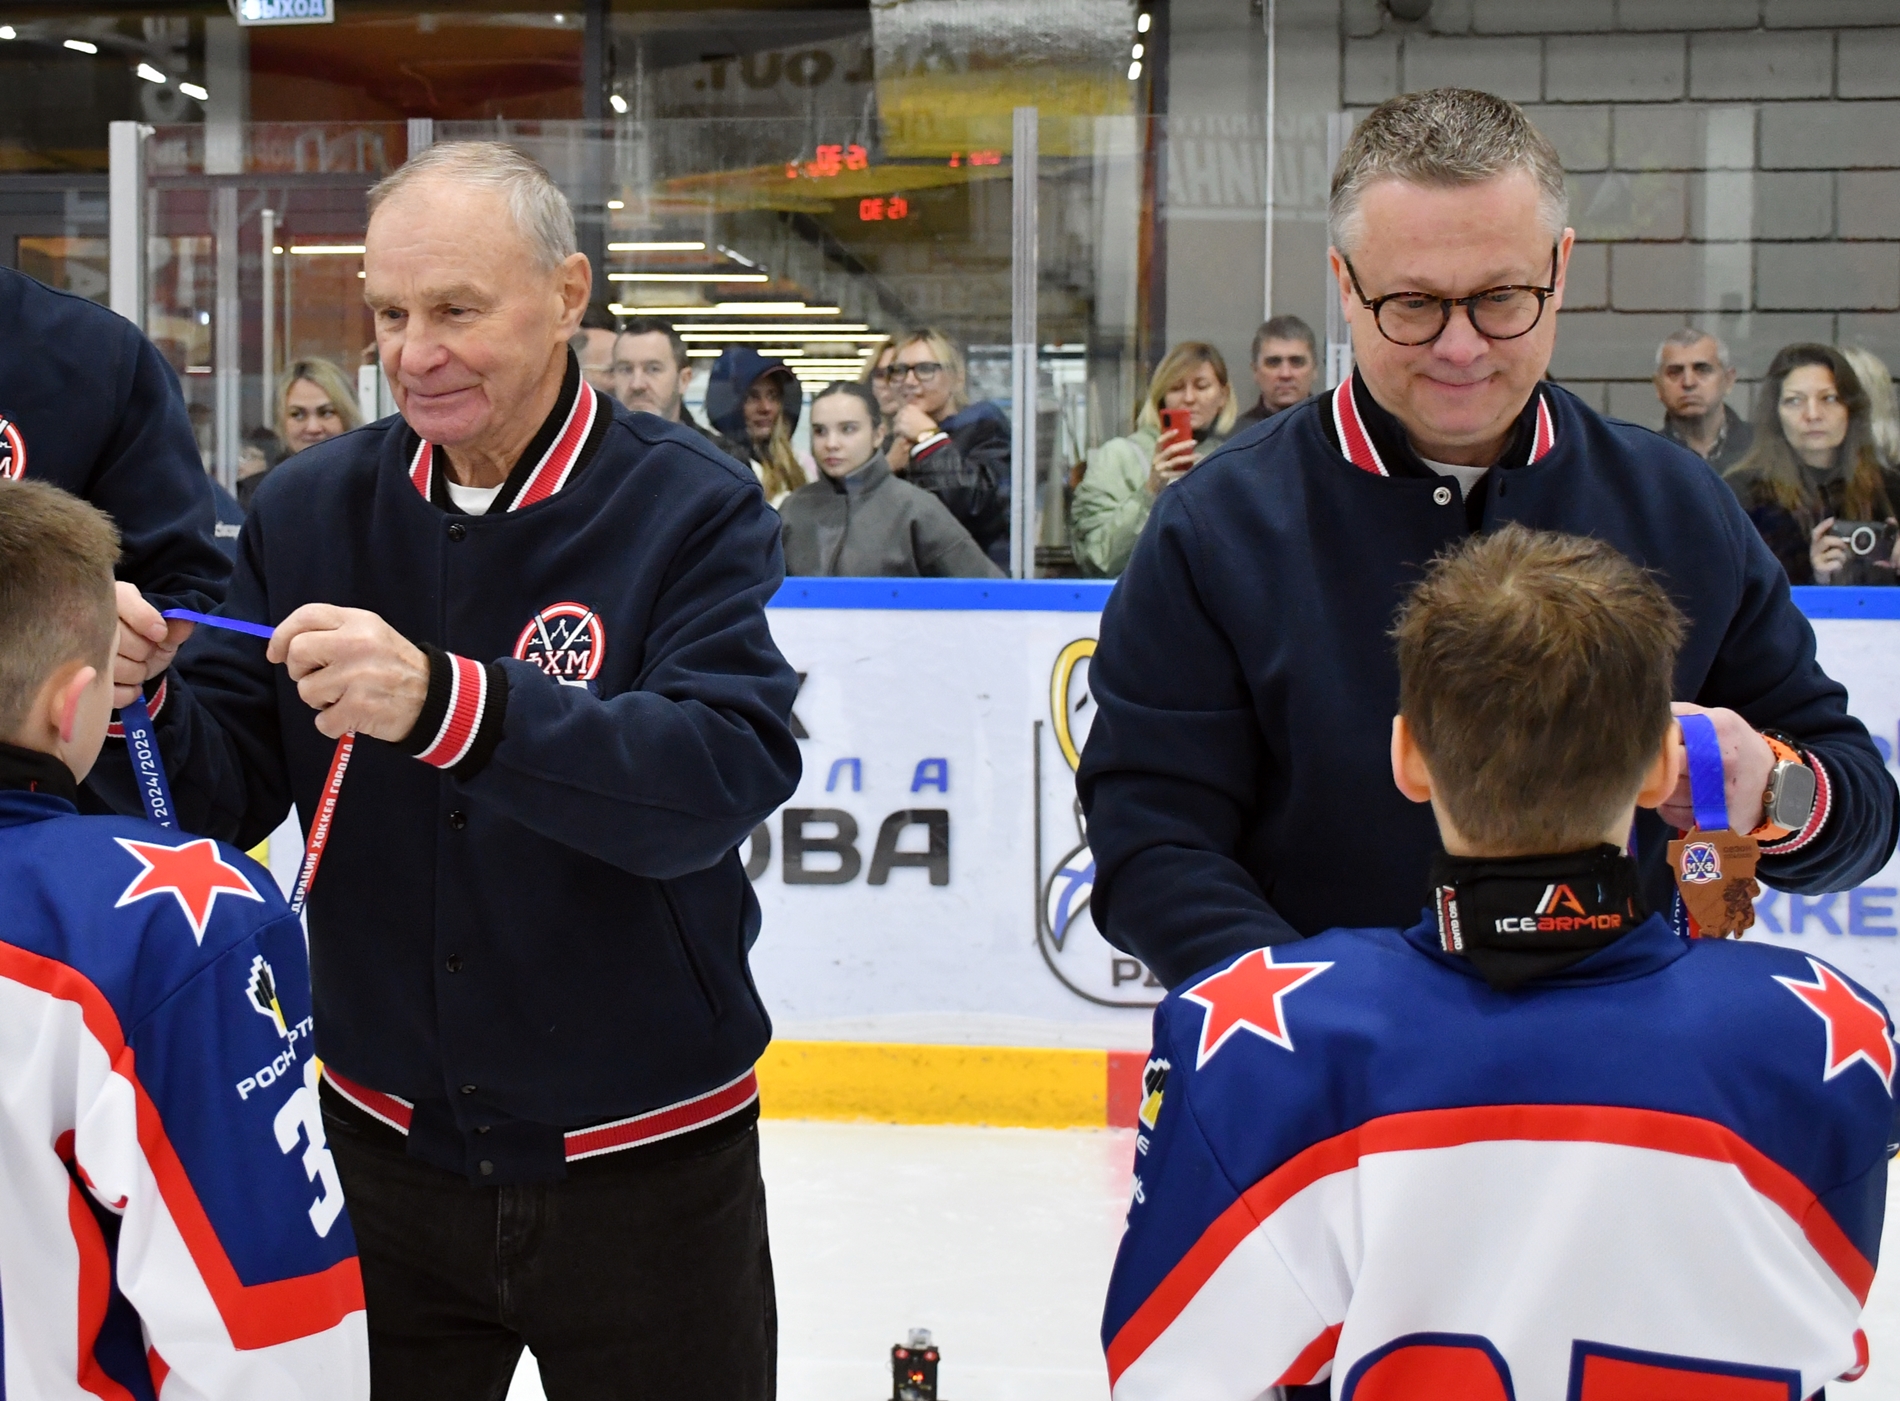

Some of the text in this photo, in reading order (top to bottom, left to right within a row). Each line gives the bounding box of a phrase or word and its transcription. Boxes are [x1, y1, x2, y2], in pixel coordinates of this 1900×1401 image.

[132, 729, 168, 818] 2024/2025
[311, 798, 337, 849] ХОККЕЯ
[1450, 919, 1463, 950] GUARD
